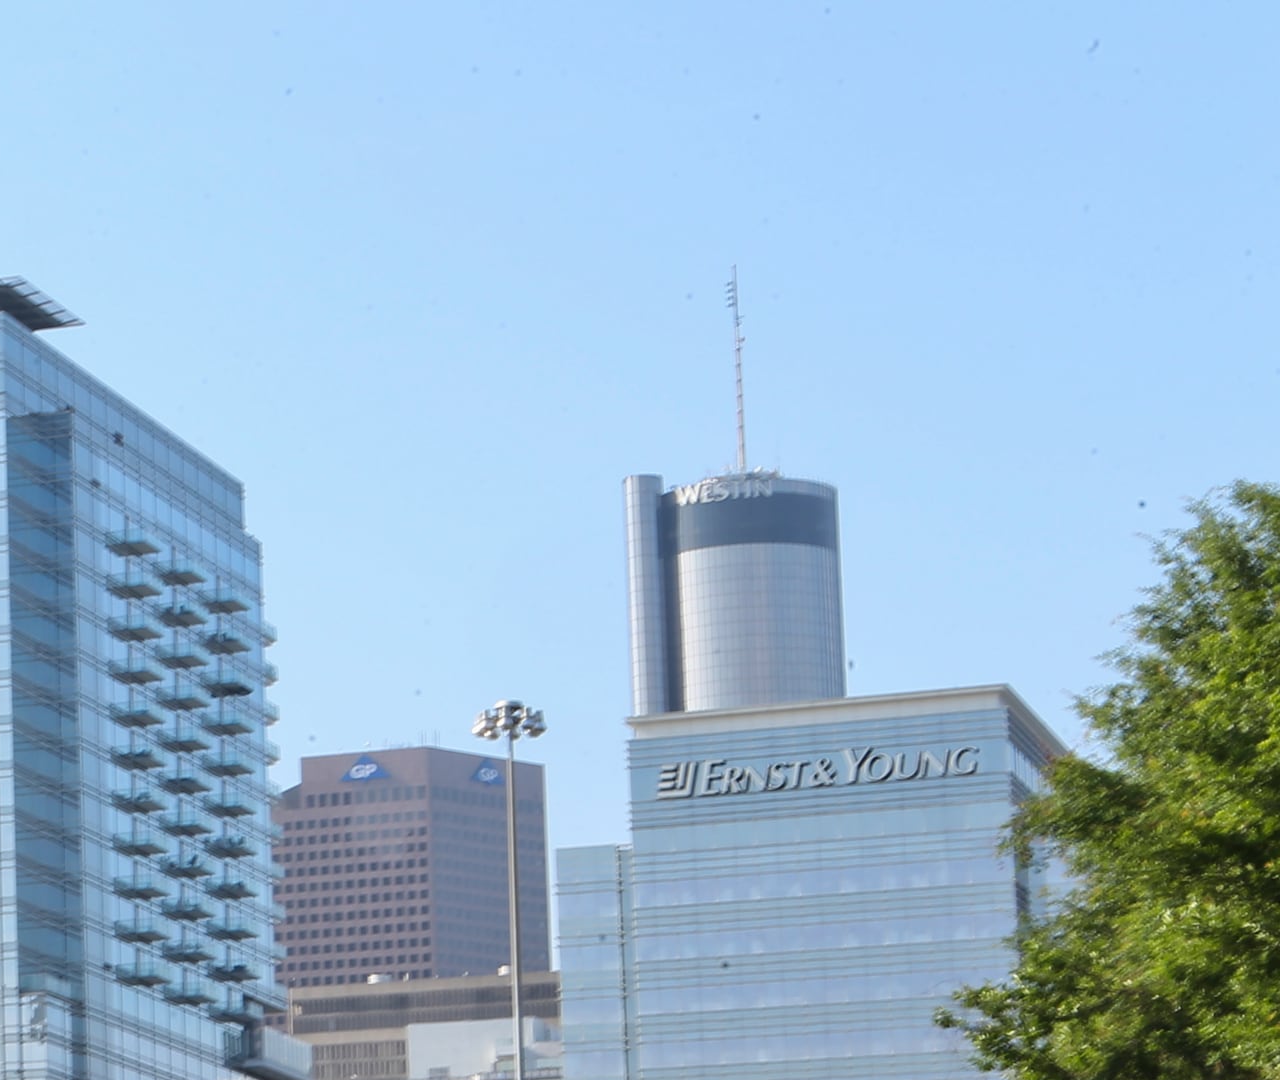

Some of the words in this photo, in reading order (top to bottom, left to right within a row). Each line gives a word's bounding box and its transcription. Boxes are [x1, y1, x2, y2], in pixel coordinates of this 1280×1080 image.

[674, 478, 774, 506] WESTIN
[349, 763, 377, 779] GP
[698, 761, 811, 796] ERNST
[810, 757, 837, 788] &
[844, 745, 980, 785] YOUNG
